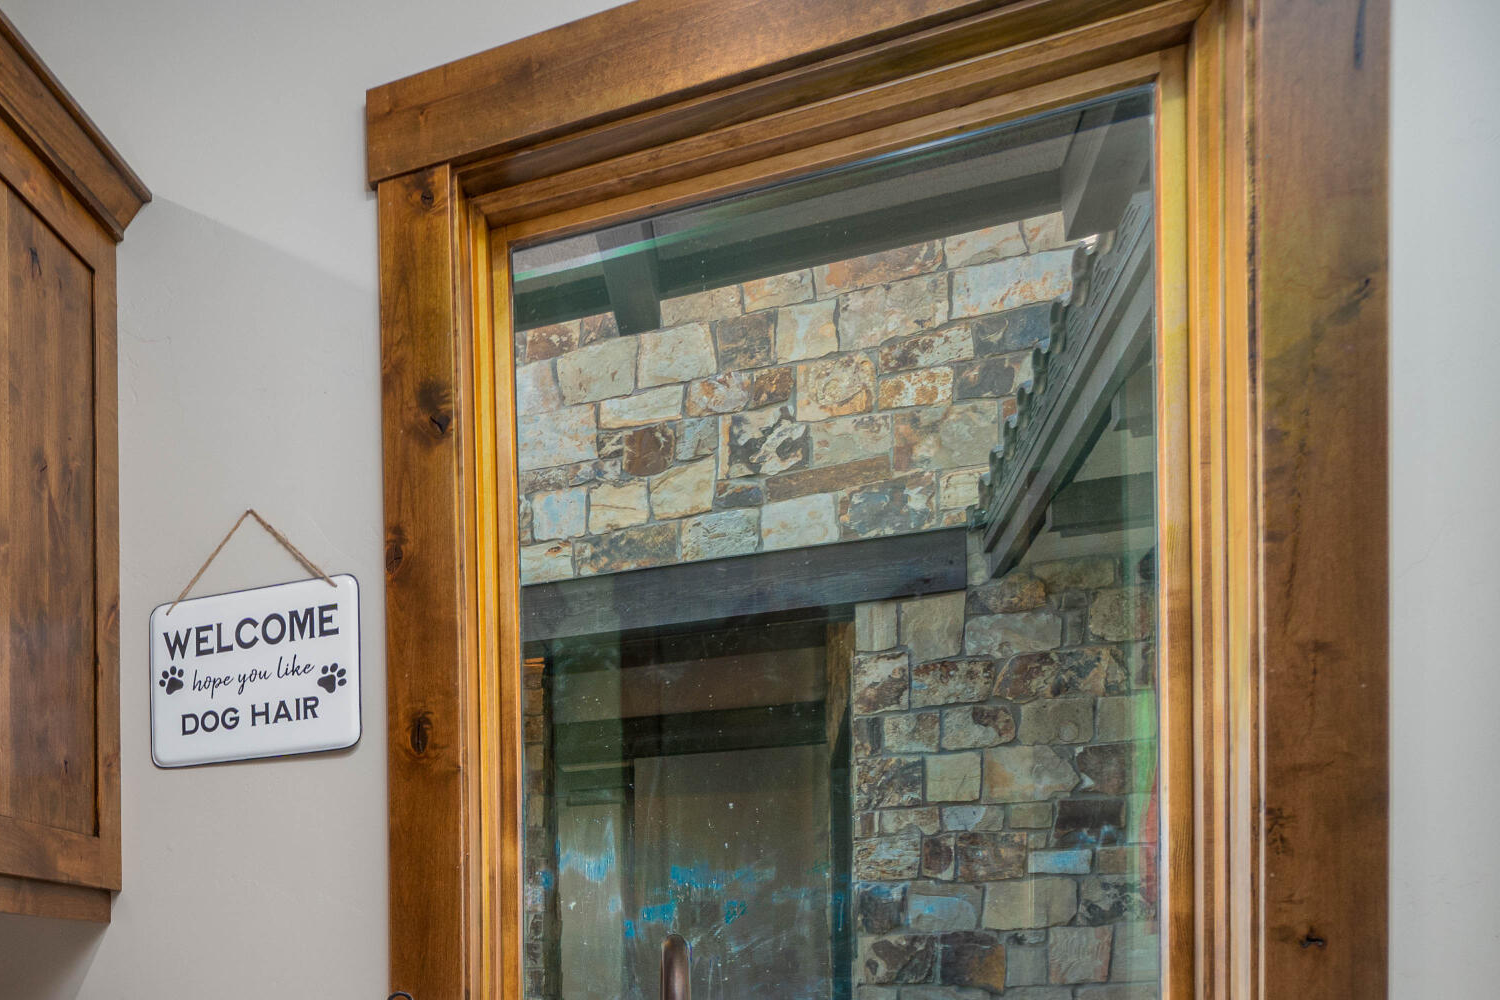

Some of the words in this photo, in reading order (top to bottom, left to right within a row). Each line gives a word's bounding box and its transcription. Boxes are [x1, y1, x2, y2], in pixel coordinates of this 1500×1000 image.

[163, 603, 340, 661] WELCOME
[192, 669, 234, 699] hope
[237, 667, 273, 695] you
[277, 654, 315, 679] like
[181, 707, 240, 736] DOG
[250, 696, 320, 727] HAIR
